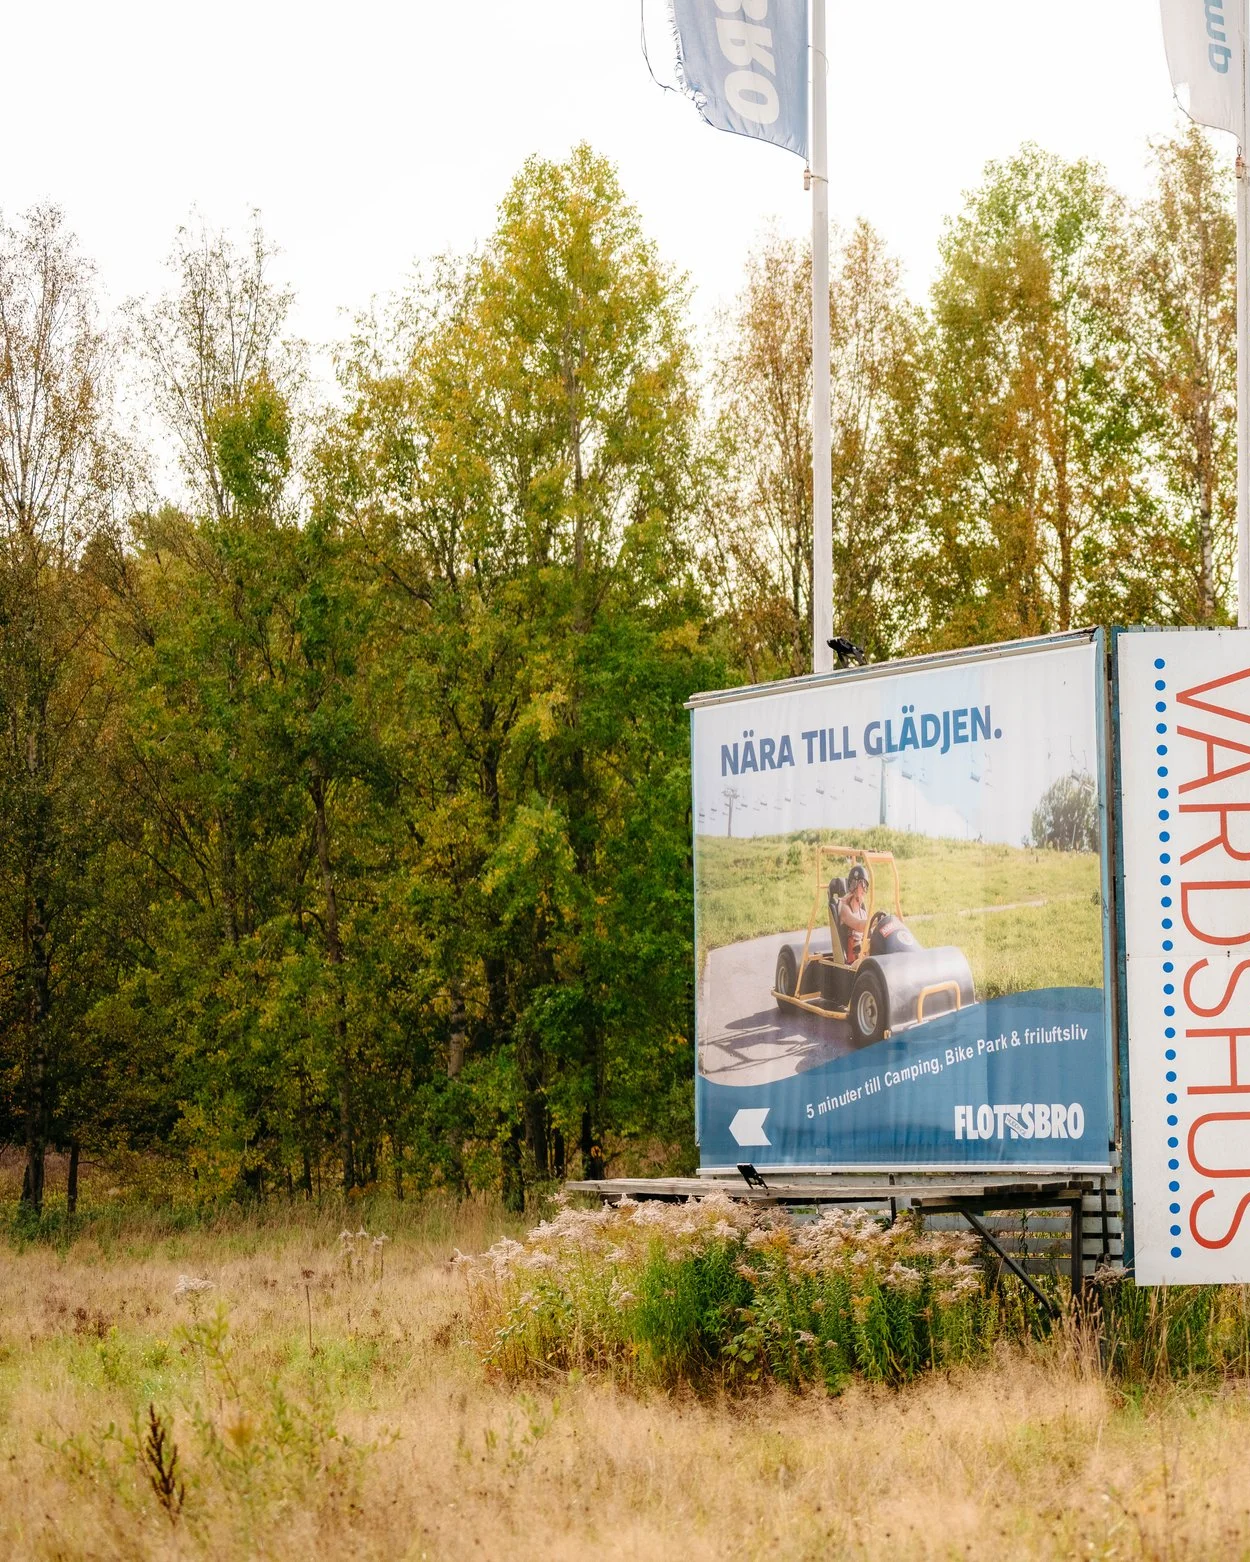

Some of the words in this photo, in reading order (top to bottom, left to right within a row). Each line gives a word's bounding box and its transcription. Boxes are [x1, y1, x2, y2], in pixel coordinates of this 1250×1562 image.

[720, 730, 795, 776] NÄRA
[802, 725, 857, 765] TILL
[863, 705, 1003, 755] GLÄDJEN.
[806, 1103, 815, 1119] 5
[818, 1086, 863, 1115] minuter
[864, 1076, 881, 1096] till
[884, 1057, 943, 1087] Camping,
[945, 1045, 974, 1066] Bike
[977, 1033, 1008, 1055] Park
[1010, 1030, 1021, 1047] &
[1024, 1023, 1088, 1045] friluftsliv
[954, 1102, 1085, 1140] FLOTTSBRO
